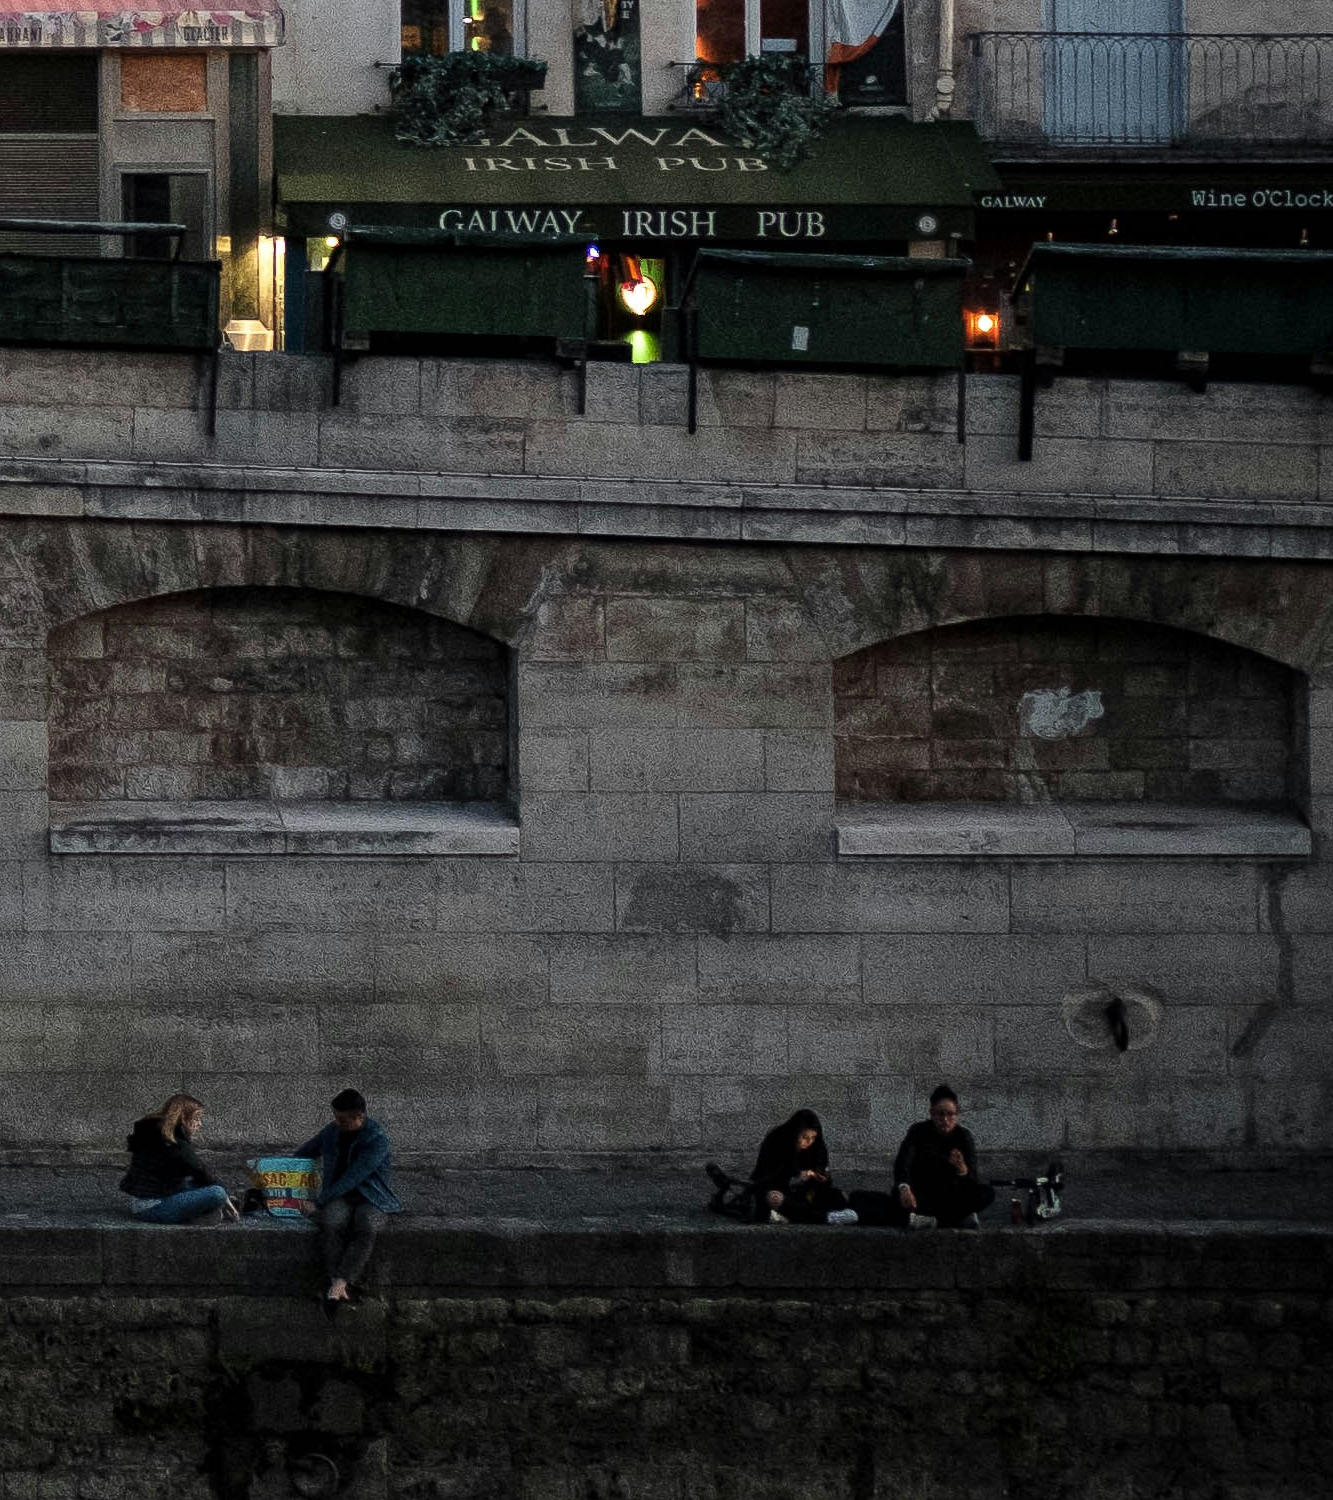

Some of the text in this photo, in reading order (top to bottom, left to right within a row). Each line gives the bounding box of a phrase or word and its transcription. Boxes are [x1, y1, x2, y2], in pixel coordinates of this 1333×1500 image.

[182, 26, 229, 43] GLACIER
[459, 127, 755, 148] ALWA
[464, 156, 770, 172] IRISH PUB
[980, 195, 1048, 209] GALWAY
[1190, 189, 1247, 207] Wine
[438, 210, 826, 238] GALWAY IRISH PUB
